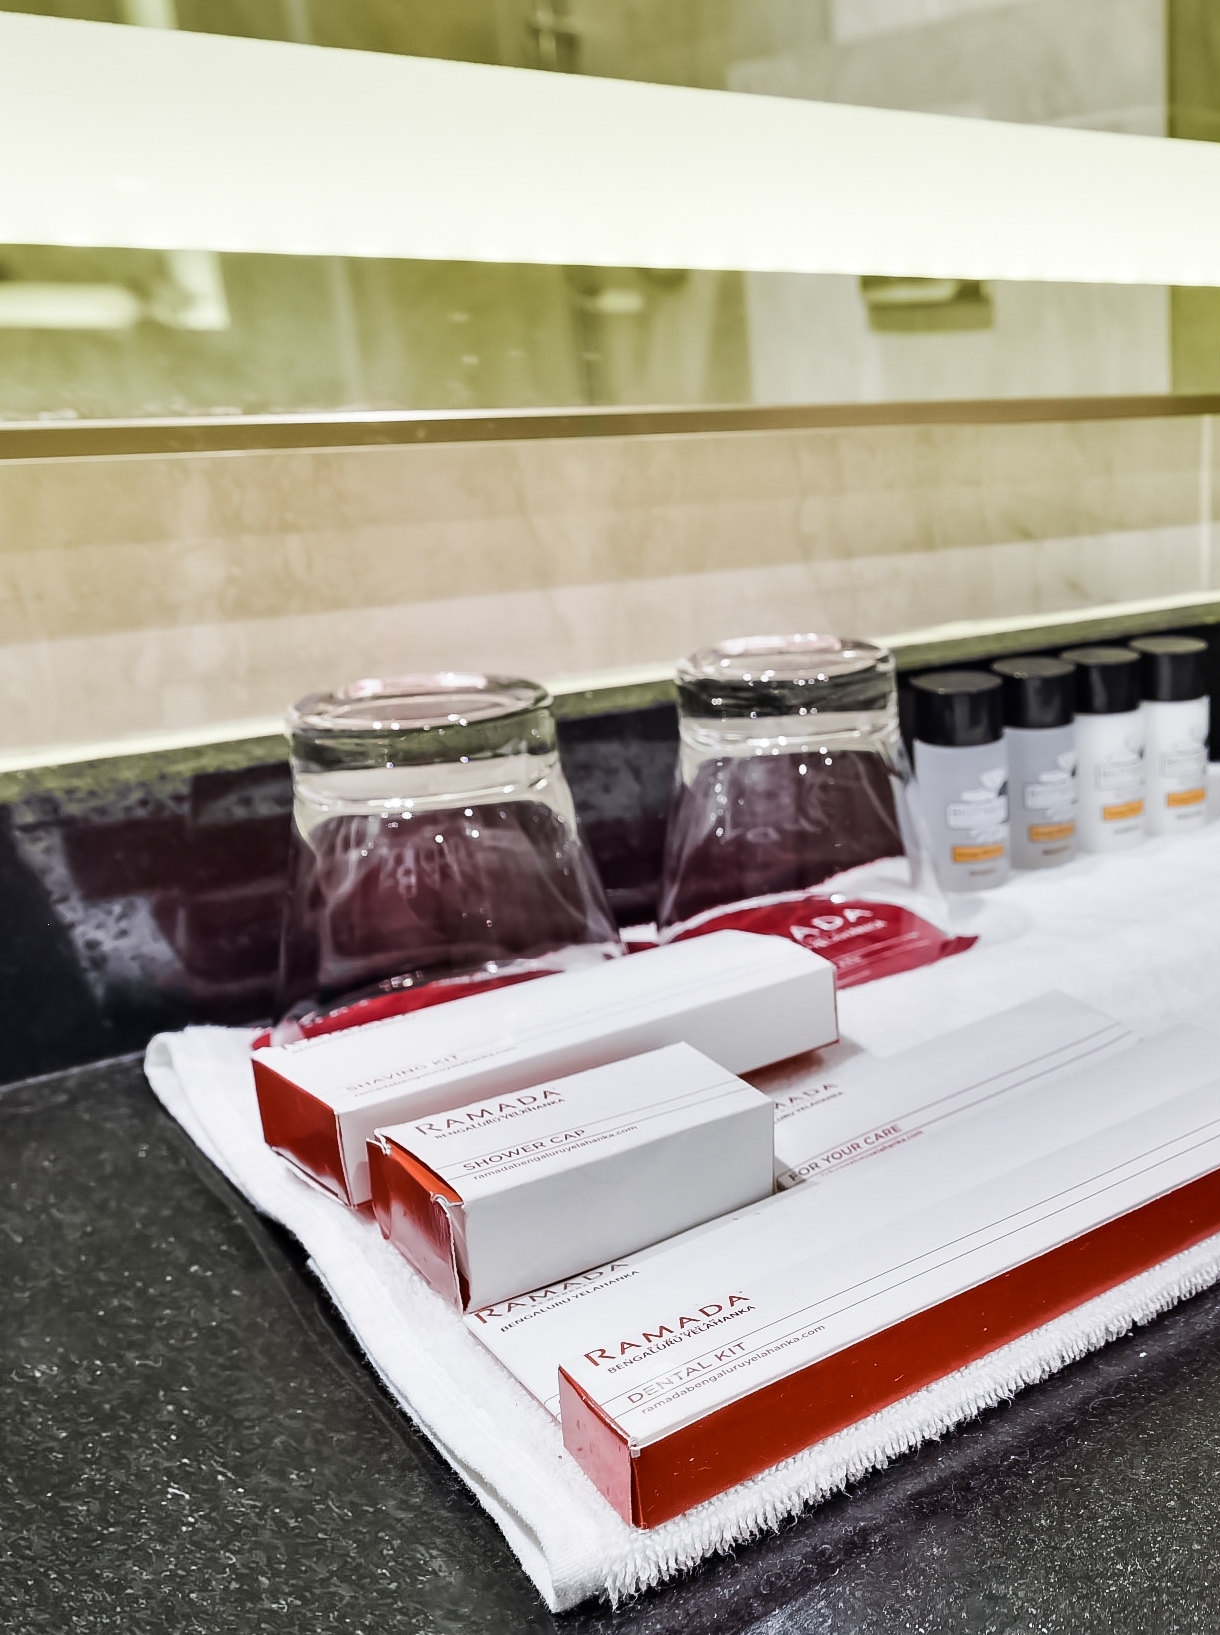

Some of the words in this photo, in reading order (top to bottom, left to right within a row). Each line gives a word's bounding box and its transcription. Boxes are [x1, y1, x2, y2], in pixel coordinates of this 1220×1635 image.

[790, 908, 874, 945] ADA
[346, 1063, 428, 1091] SHAVING
[432, 1054, 459, 1067] KIT
[415, 1089, 562, 1136] RAMADA
[463, 1140, 547, 1171] SHOWER
[549, 1128, 586, 1145] CAP
[473, 1124, 638, 1181] ramadabengaluruyelahanka.com
[788, 1161, 821, 1182] FOR
[821, 1142, 862, 1165] YOUR
[863, 1123, 902, 1146] CARE
[474, 1262, 629, 1324] RAMADA
[500, 1297, 571, 1333] BENGALURU
[571, 1269, 640, 1298] YELAHANKA
[583, 1293, 751, 1367] RAMADA
[606, 1335, 683, 1374] BENGALURU
[684, 1304, 756, 1339] YELAHANKA
[626, 1360, 713, 1404] DENTAL
[714, 1341, 748, 1363] KIT
[641, 1323, 826, 1415] ramadabengaluruyelahanka.com
